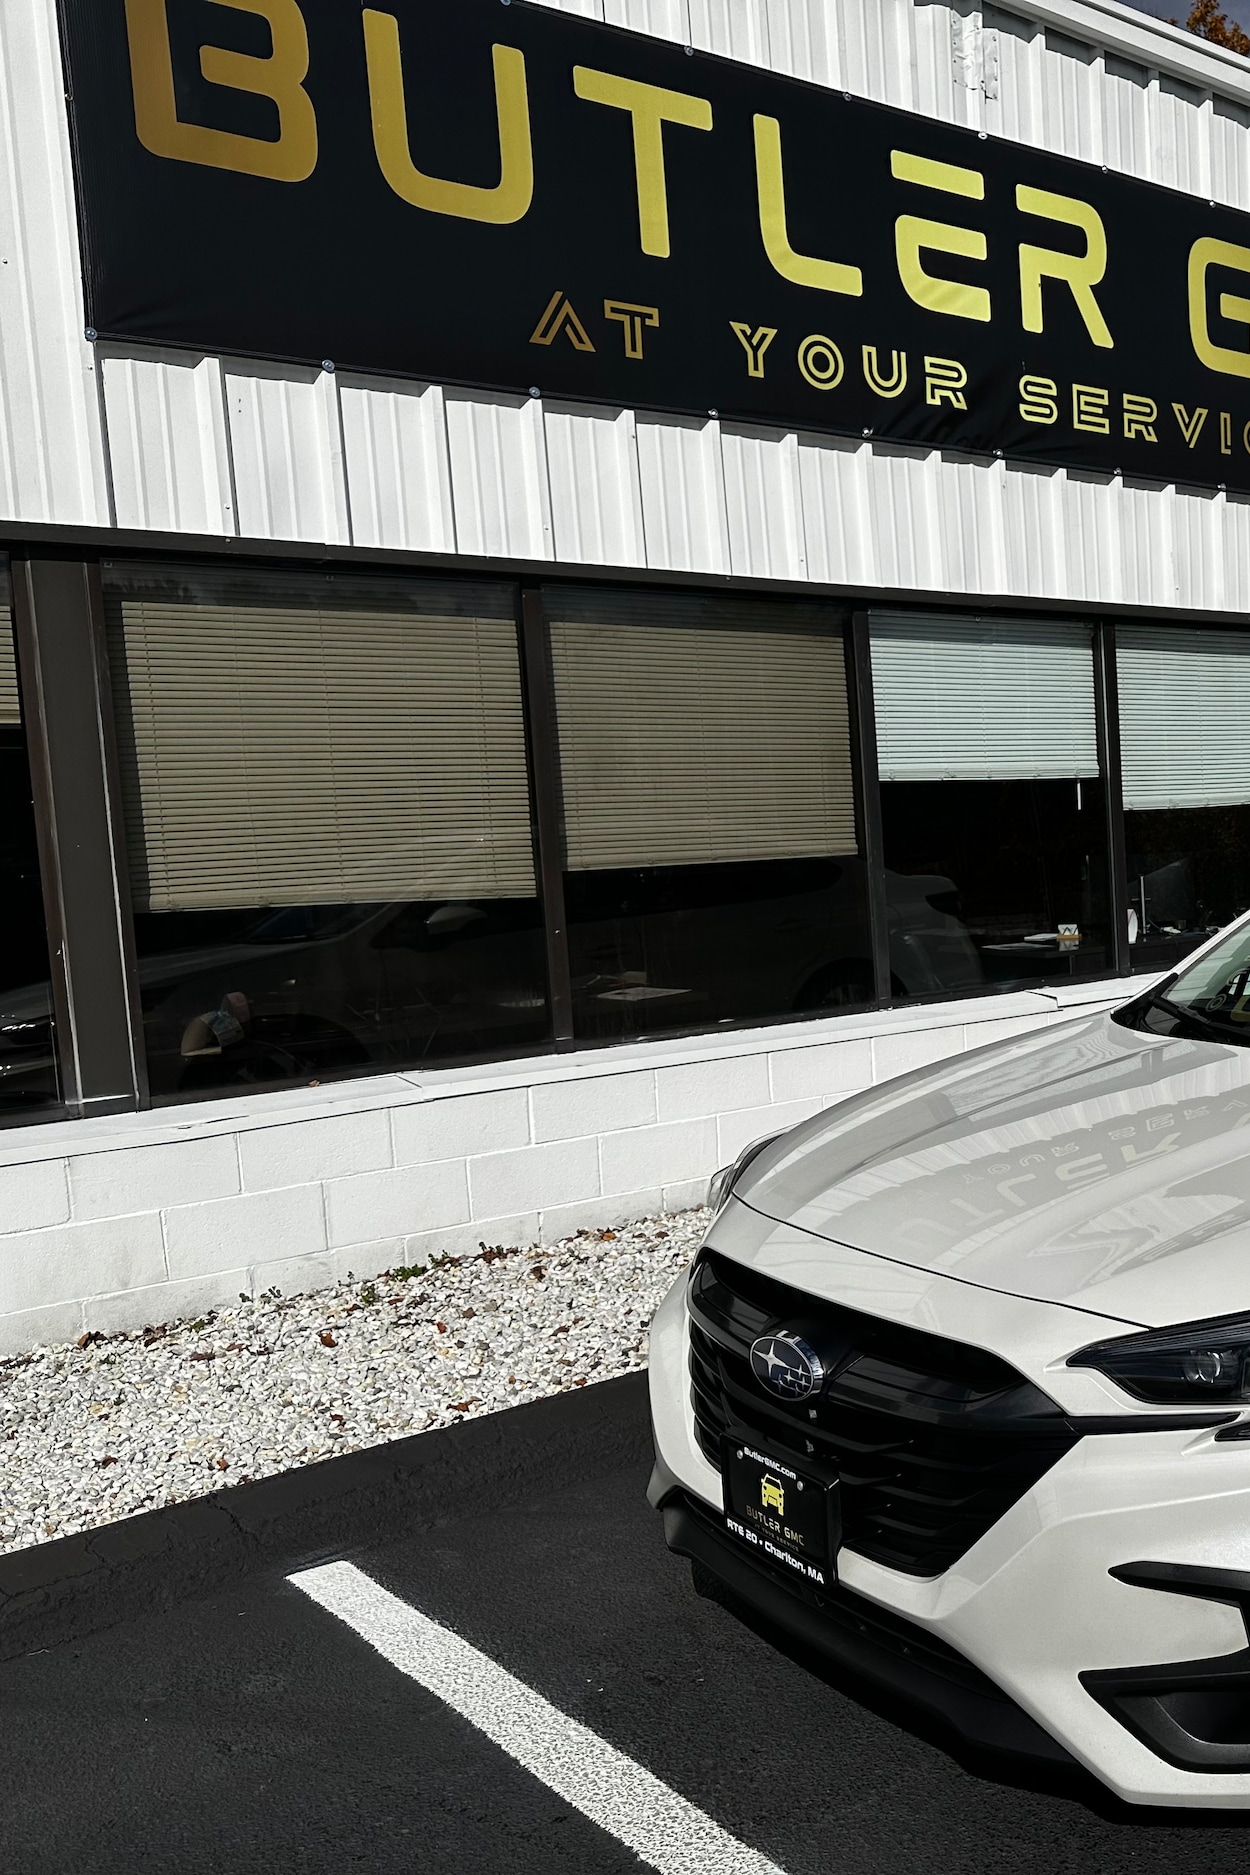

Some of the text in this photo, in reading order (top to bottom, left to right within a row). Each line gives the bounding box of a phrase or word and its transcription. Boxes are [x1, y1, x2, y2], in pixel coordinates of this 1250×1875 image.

[125, 0, 1114, 349] BUTLER
[529, 291, 660, 360] AT
[729, 321, 968, 411] YOUR
[743, 1446, 796, 1480] ButlerGMC.com
[726, 1518, 744, 1536] RTE
[745, 1529, 757, 1544] 20
[807, 1566, 824, 1585] MA
[746, 1504, 780, 1533] BUTLER
[784, 1526, 804, 1547] GMC
